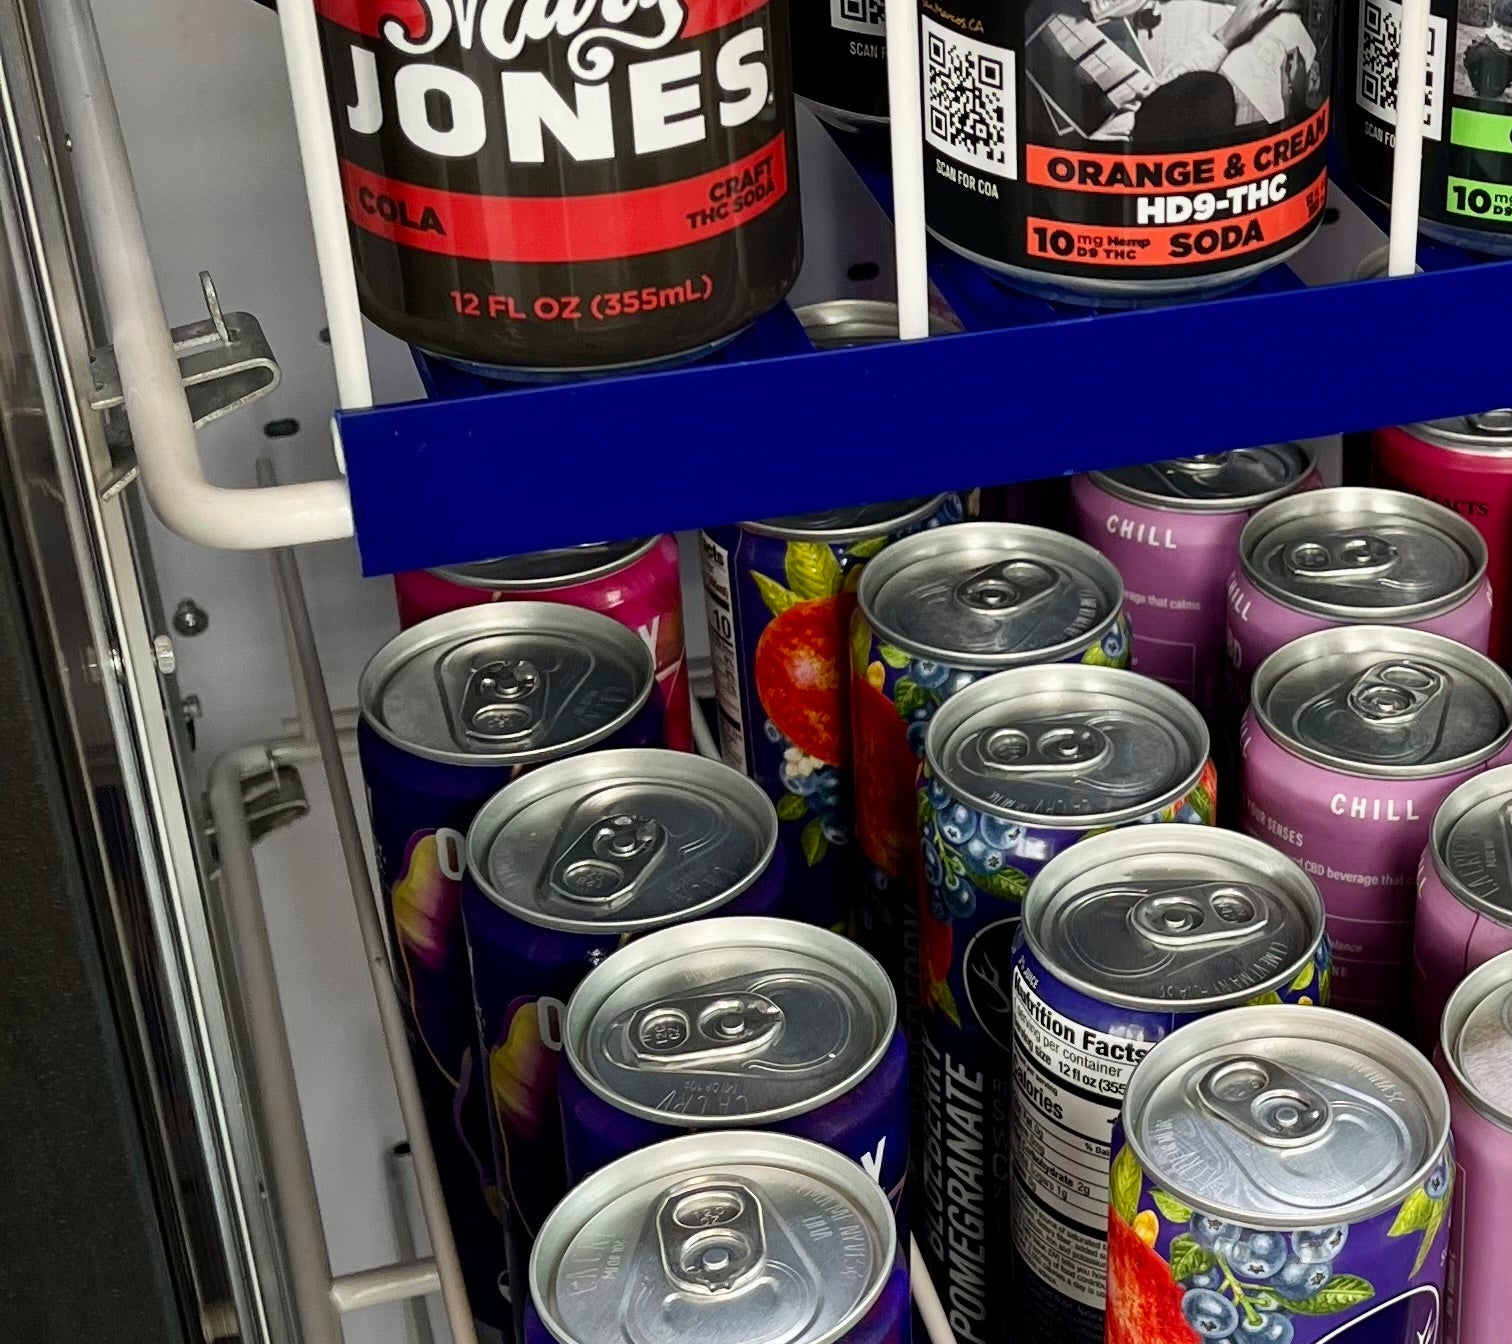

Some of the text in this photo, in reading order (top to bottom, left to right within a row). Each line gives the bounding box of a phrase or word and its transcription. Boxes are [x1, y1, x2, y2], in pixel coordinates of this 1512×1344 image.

[346, 26, 769, 164] JONES
[1046, 110, 1329, 189] ORANGE & CREAM
[708, 156, 776, 204] CRAFT
[936, 159, 999, 198] SCAN FOR COA
[1136, 174, 1287, 226] HD9-THC
[1452, 186, 1492, 215] 10
[359, 185, 446, 236] COLA
[686, 178, 777, 230] THC SODA
[1033, 219, 1266, 260] 10 SODA
[451, 275, 714, 322] 12 FL OZ (355mL)
[1105, 513, 1178, 550] CHILL
[1330, 792, 1421, 822] CHILL
[1063, 1050, 1123, 1078] container
[1083, 1031, 1147, 1063] Facts
